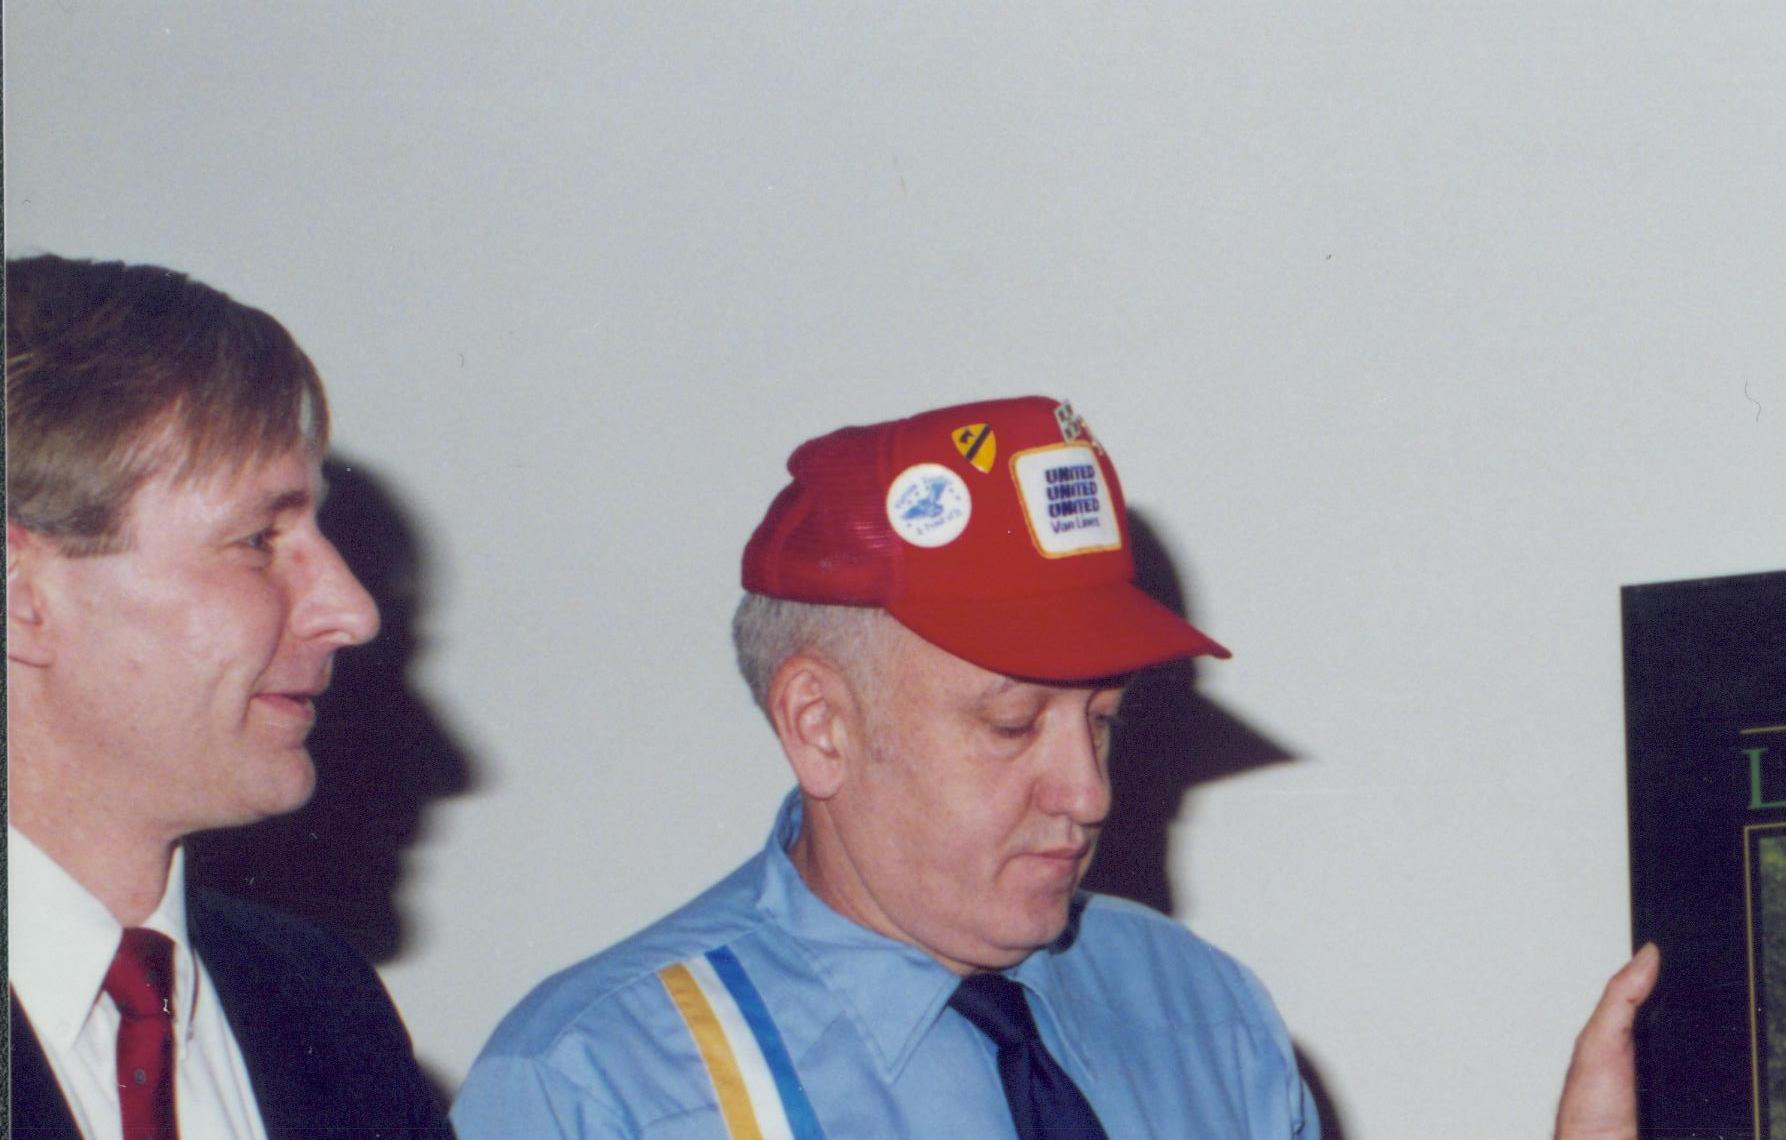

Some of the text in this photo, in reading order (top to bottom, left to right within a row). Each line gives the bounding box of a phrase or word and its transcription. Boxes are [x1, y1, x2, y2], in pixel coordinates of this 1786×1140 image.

[1044, 464, 1095, 484] UNITED
[1046, 480, 1098, 501] UNITED
[1048, 497, 1100, 518] UNITED
[1051, 519, 1074, 534] Van
